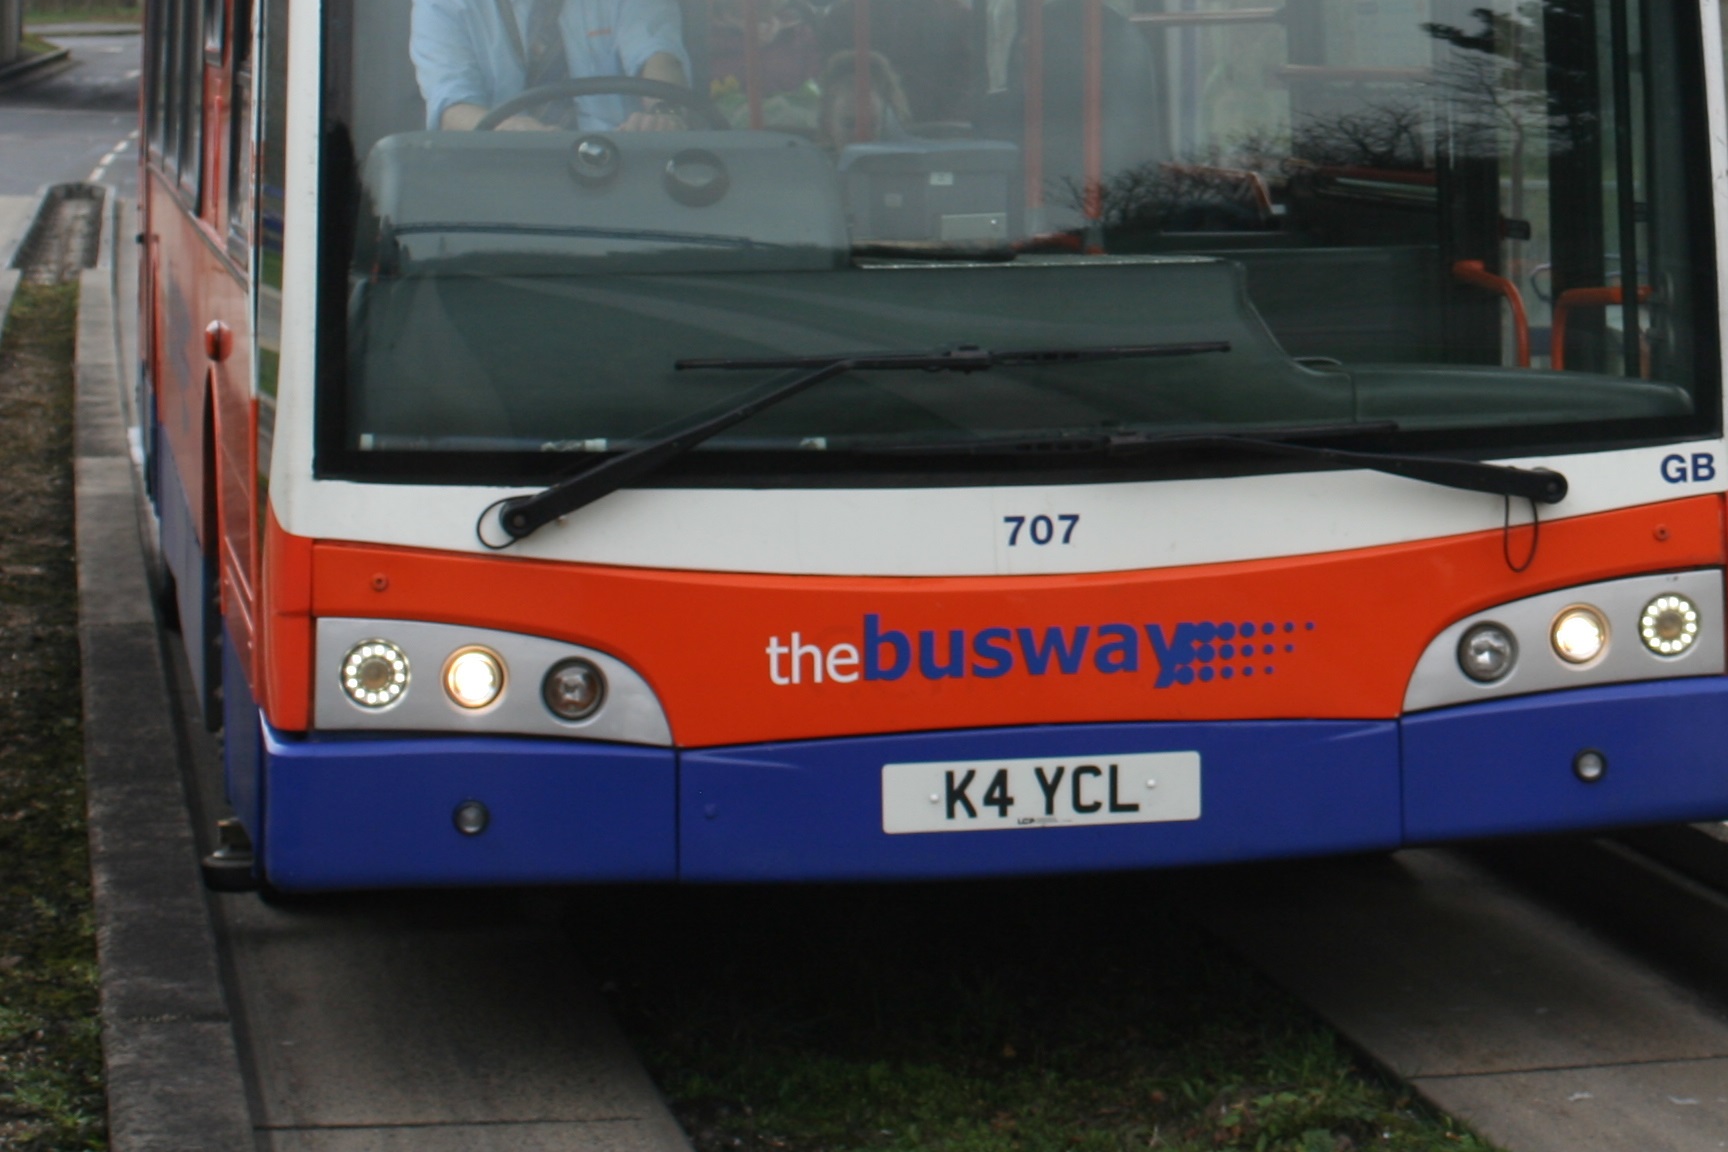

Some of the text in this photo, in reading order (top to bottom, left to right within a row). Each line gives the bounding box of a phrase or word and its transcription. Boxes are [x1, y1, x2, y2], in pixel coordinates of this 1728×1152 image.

[1660, 452, 1716, 484] GB
[1003, 514, 1080, 547] 707
[944, 763, 1140, 820] K4 YCL
